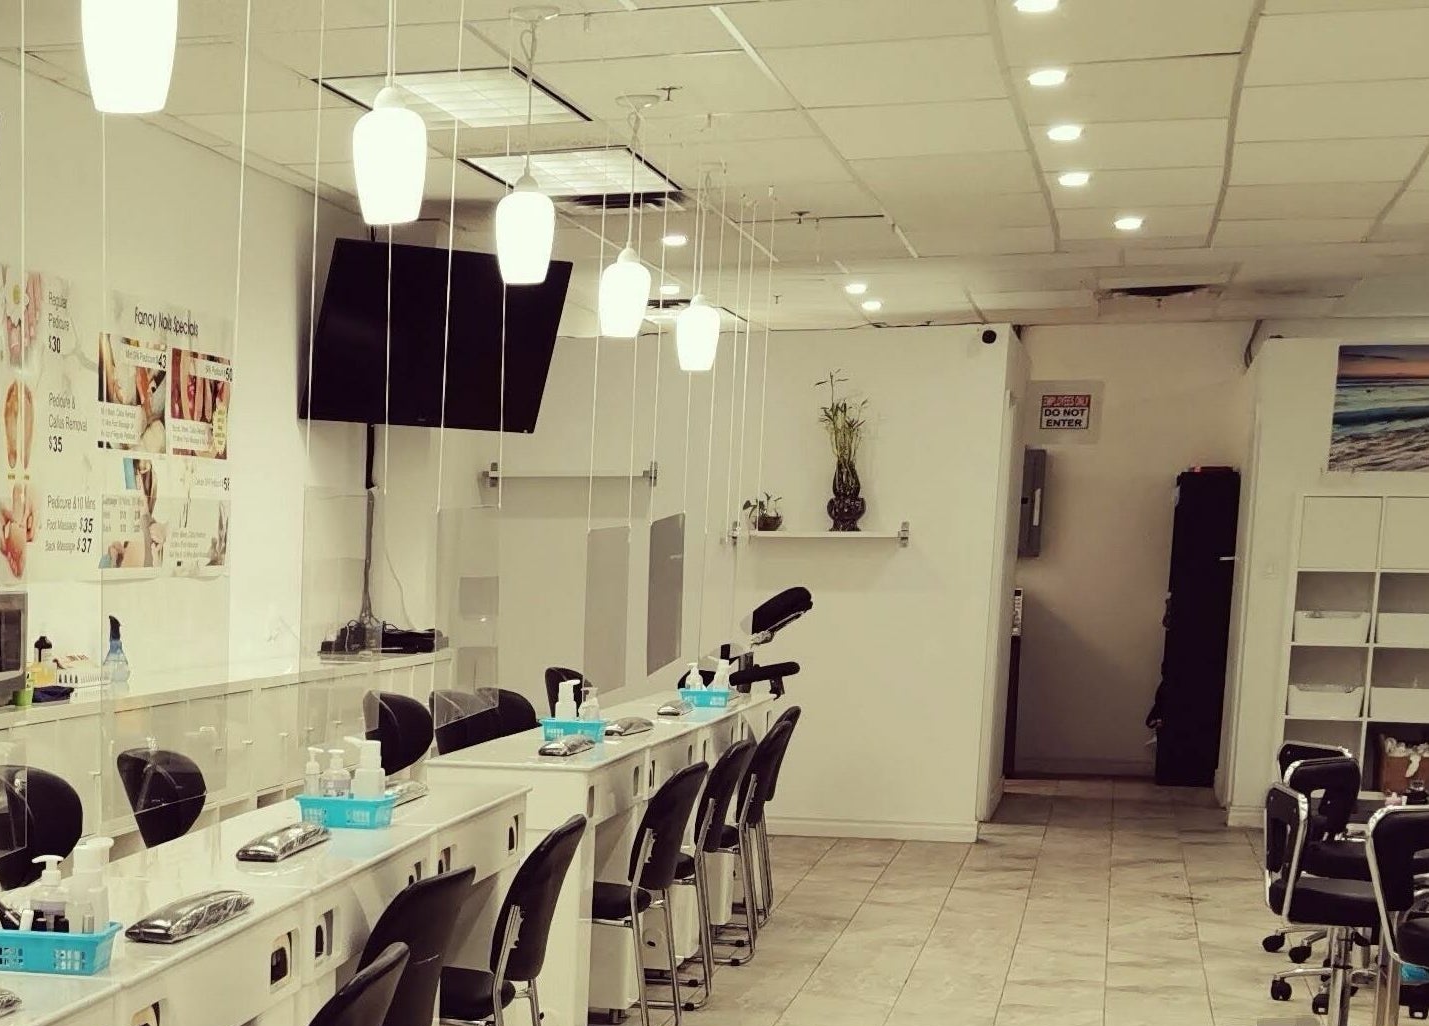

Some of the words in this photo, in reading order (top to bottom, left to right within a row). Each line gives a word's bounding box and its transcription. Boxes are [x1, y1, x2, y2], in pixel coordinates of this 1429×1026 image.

[48, 313, 69, 331] Pedicure
[134, 306, 157, 330] Fancy
[158, 311, 172, 331] Nails
[1044, 408, 1060, 416] DO
[1063, 408, 1086, 416] NOT
[65, 417, 87, 433] Removal
[1046, 419, 1082, 427] ENTER
[48, 436, 63, 453] $35
[79, 517, 94, 534] $35
[77, 538, 92, 553] $37
